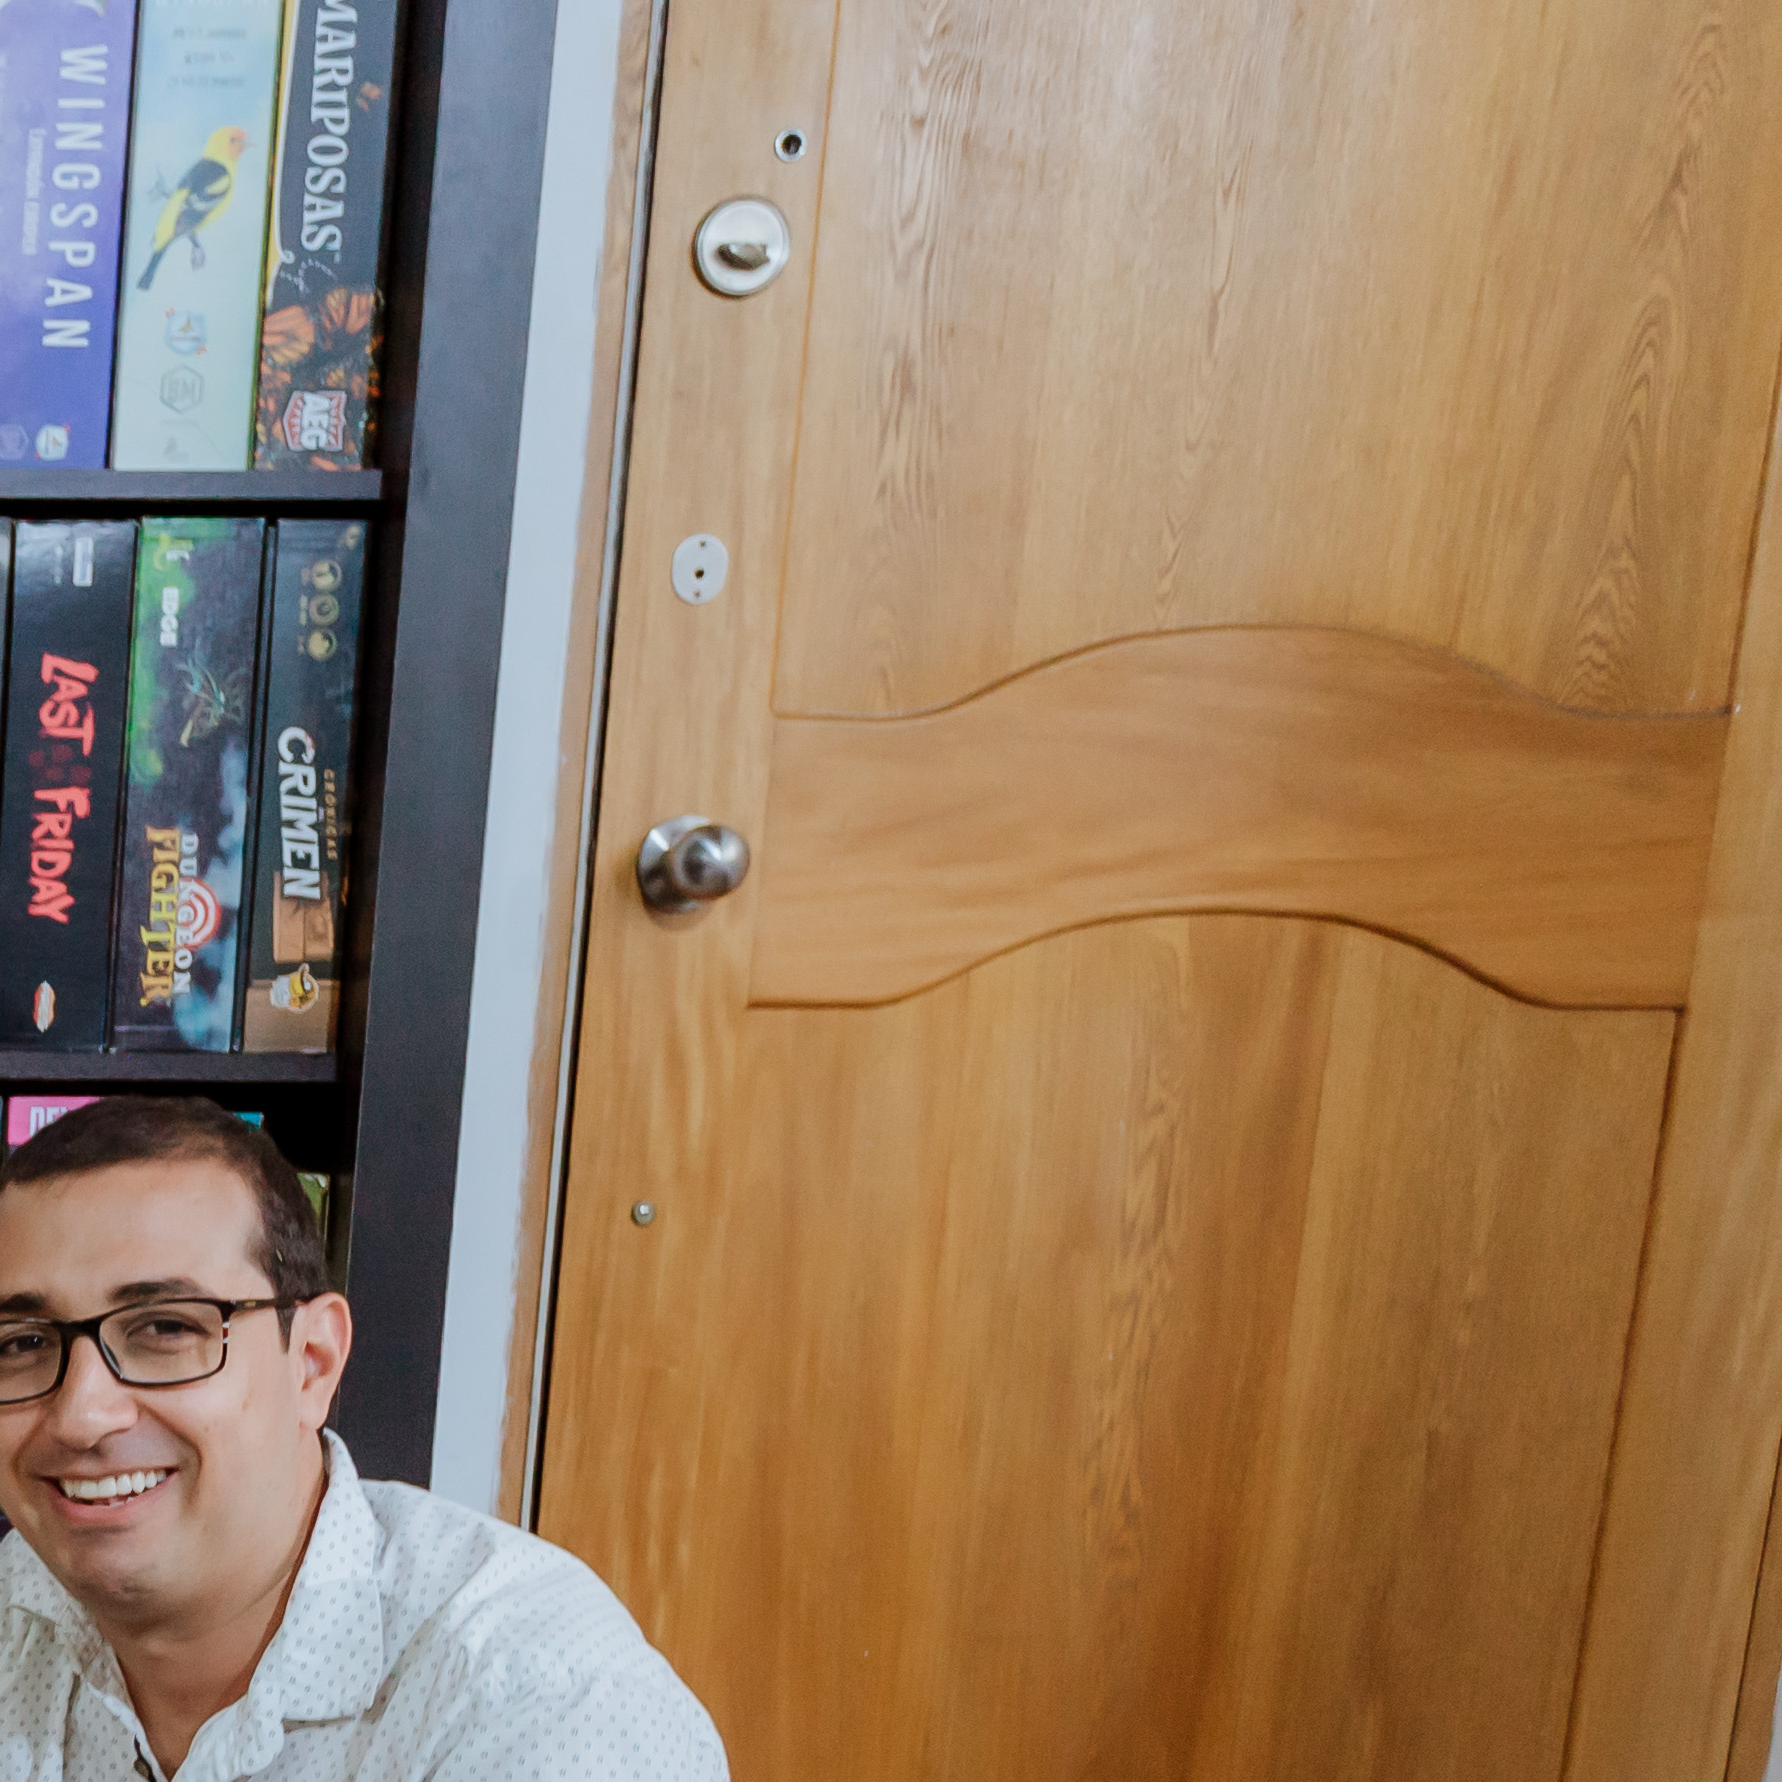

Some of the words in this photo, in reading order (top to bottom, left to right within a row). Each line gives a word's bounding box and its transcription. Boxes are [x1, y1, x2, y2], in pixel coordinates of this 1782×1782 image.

[42, 44, 108, 349] WINGSPAN
[300, 391, 332, 451] AEG
[159, 587, 180, 648] EDGE
[40, 652, 100, 757] LAST
[27, 784, 92, 925] FRIDAY
[276, 726, 321, 901] CRIMEN
[138, 823, 181, 1002] FIGHTER
[173, 832, 200, 996] DUNGEON
